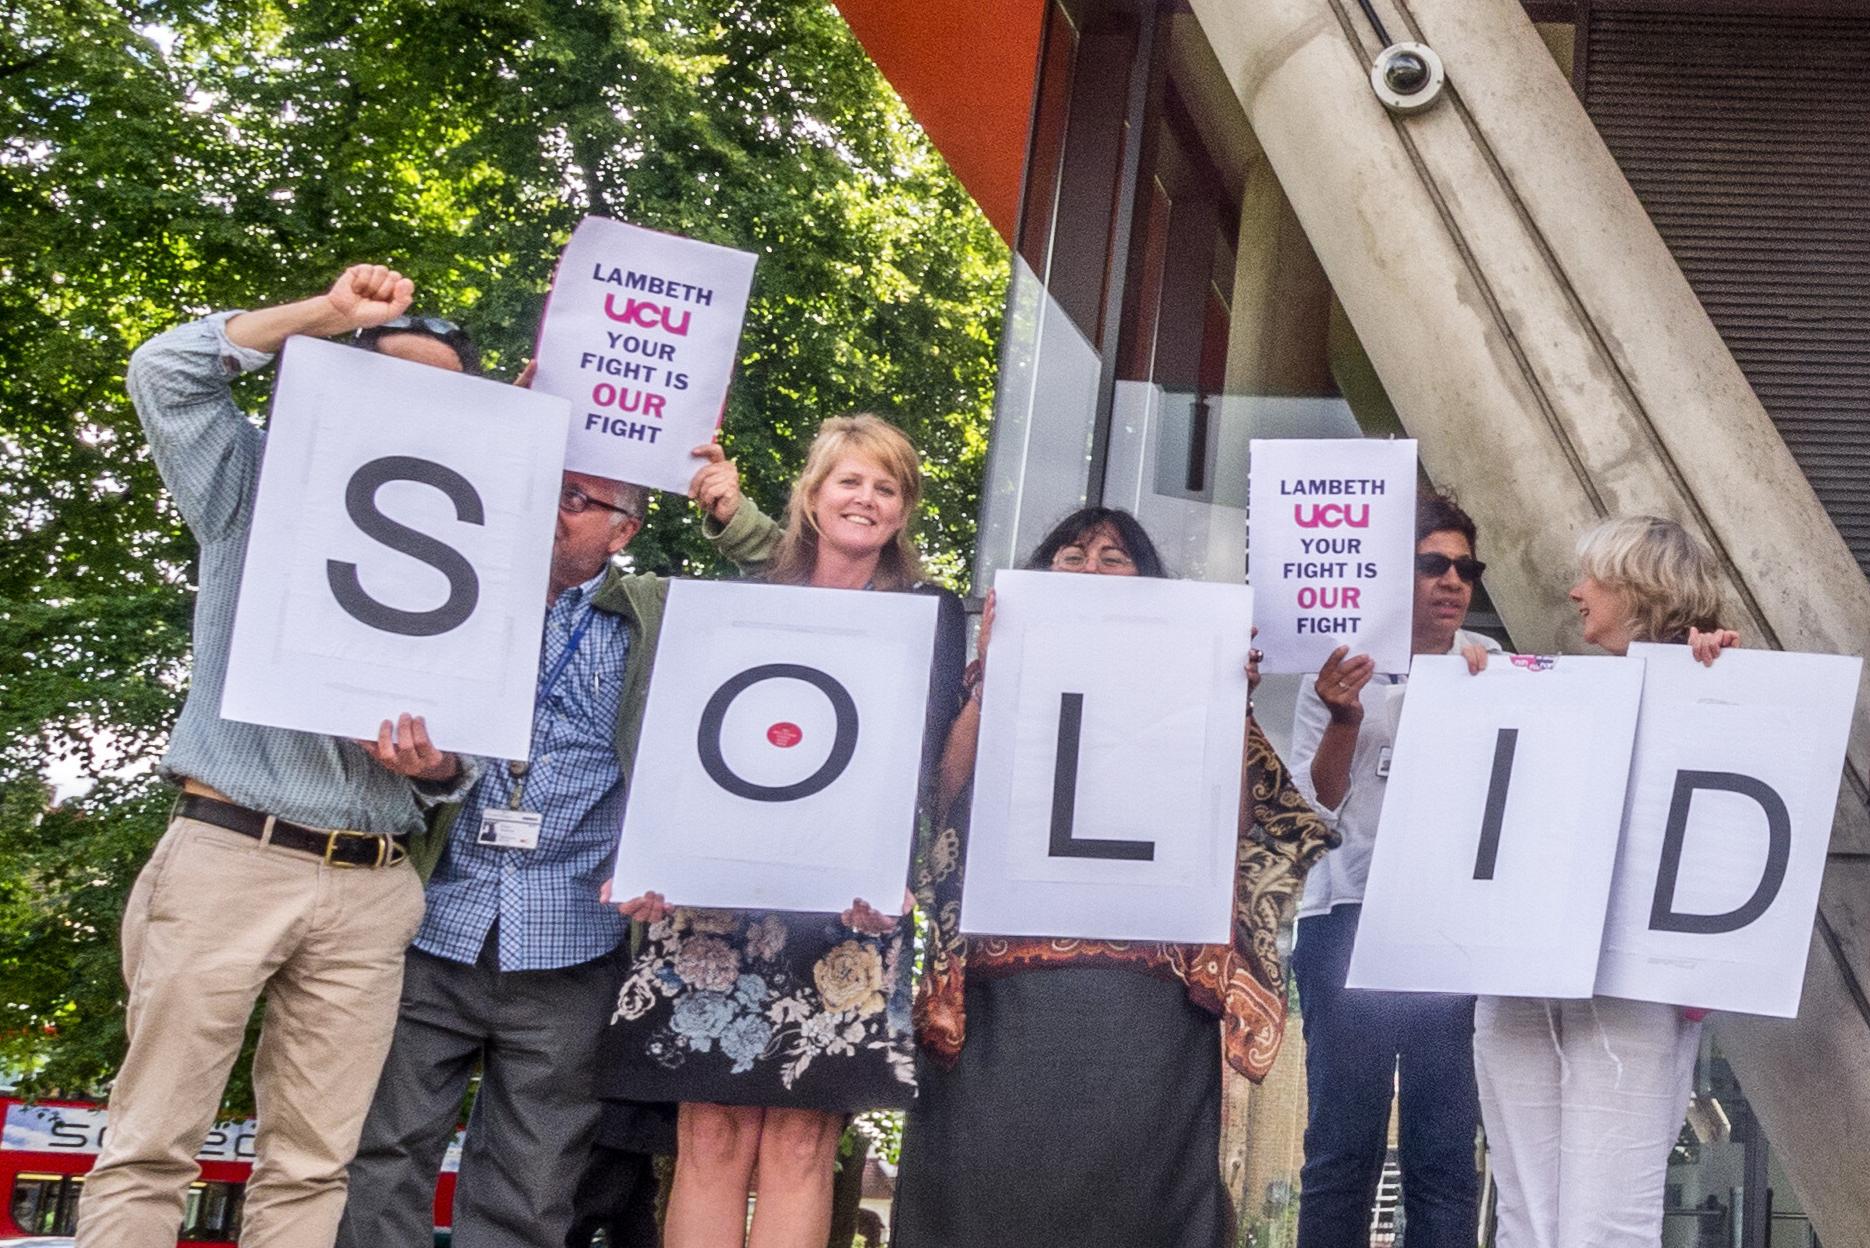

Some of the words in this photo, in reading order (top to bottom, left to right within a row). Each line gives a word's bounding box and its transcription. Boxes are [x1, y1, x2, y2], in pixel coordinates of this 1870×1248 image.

[593, 263, 713, 306] LAMBETH
[607, 331, 676, 361] YOUR
[580, 352, 657, 383] FIGHT
[665, 371, 689, 390] IS
[592, 383, 666, 419] OUR
[585, 413, 662, 443] FIGHT
[1280, 480, 1385, 495] LAMBETH
[327, 456, 484, 636] S
[1301, 539, 1361, 554] YOUR
[1283, 563, 1347, 578] FIGHT
[1357, 563, 1377, 578] IS
[1297, 587, 1361, 609] OUR
[1297, 617, 1361, 633] FIGHT
[698, 664, 858, 802] O
[1049, 693, 1154, 861] L
[1473, 729, 1518, 879] I
[1649, 770, 1790, 933] D
